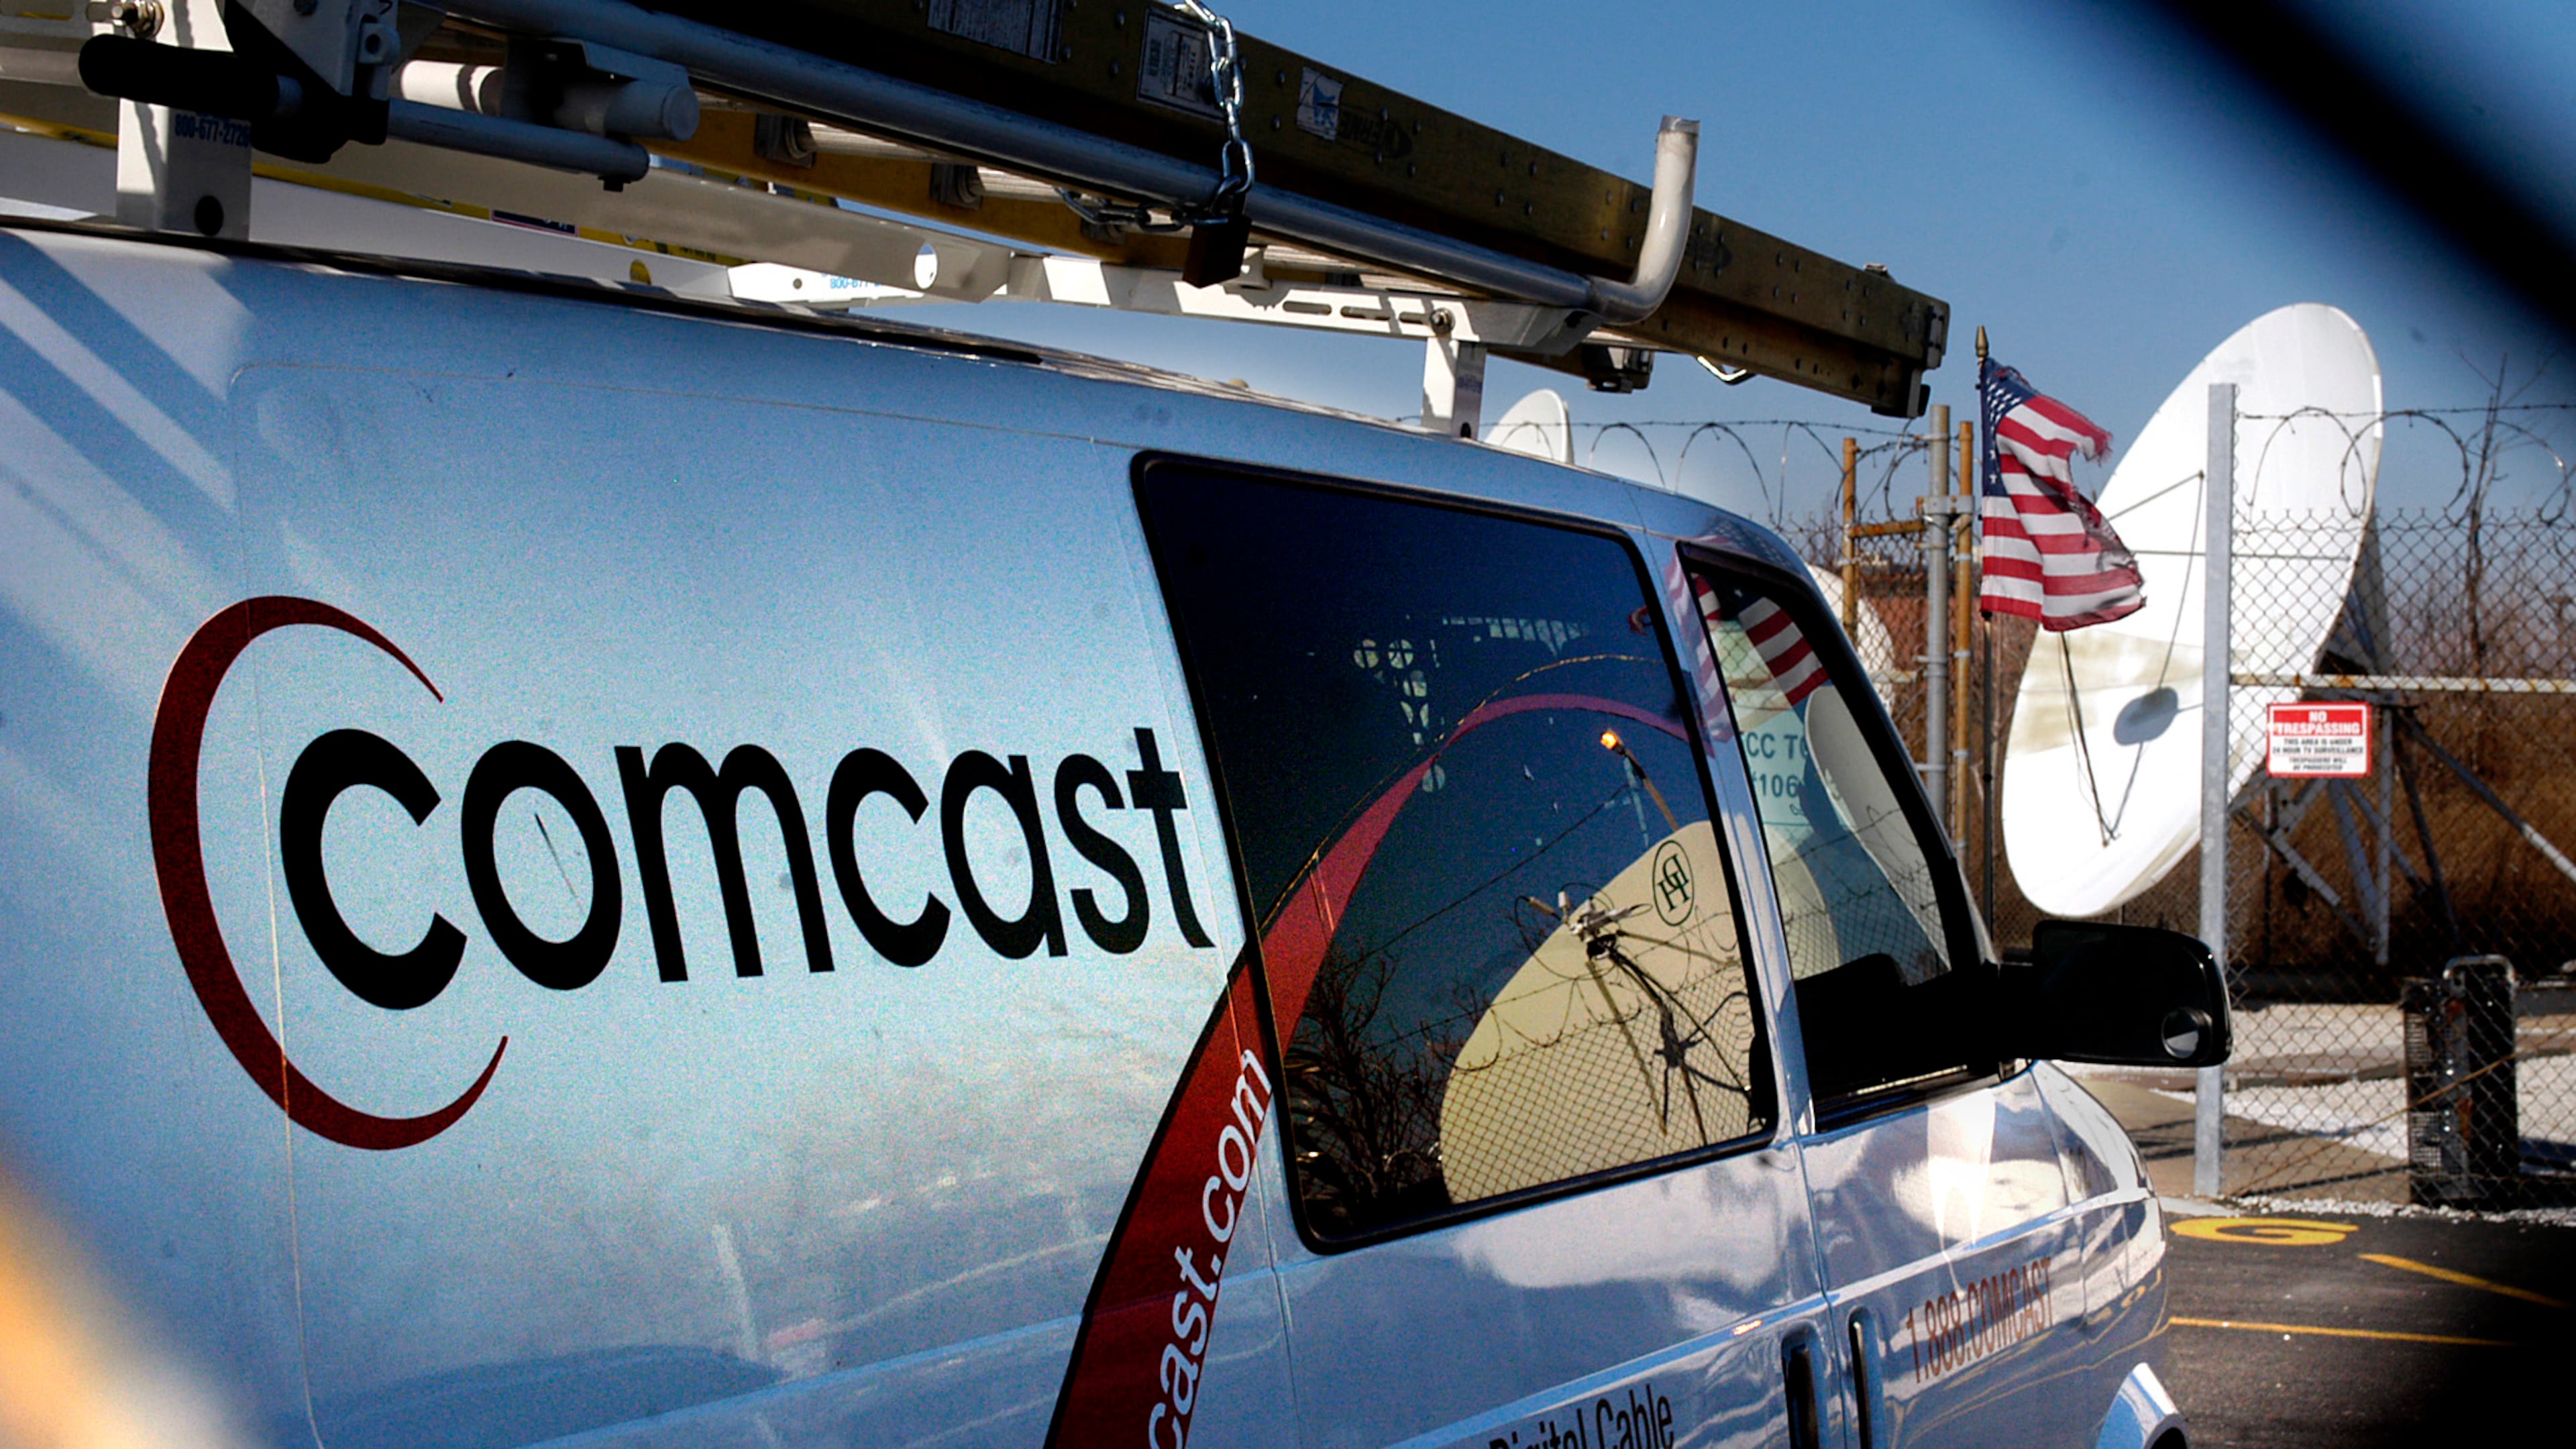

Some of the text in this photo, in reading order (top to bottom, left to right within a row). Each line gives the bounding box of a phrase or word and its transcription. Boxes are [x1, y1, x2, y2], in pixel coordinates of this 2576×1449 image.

[2309, 711, 2327, 722] NO
[2276, 722, 2360, 734] TRESPASSING
[1743, 732, 1776, 759] CC
[1907, 1256, 2053, 1384] 1.888.COMCAST
